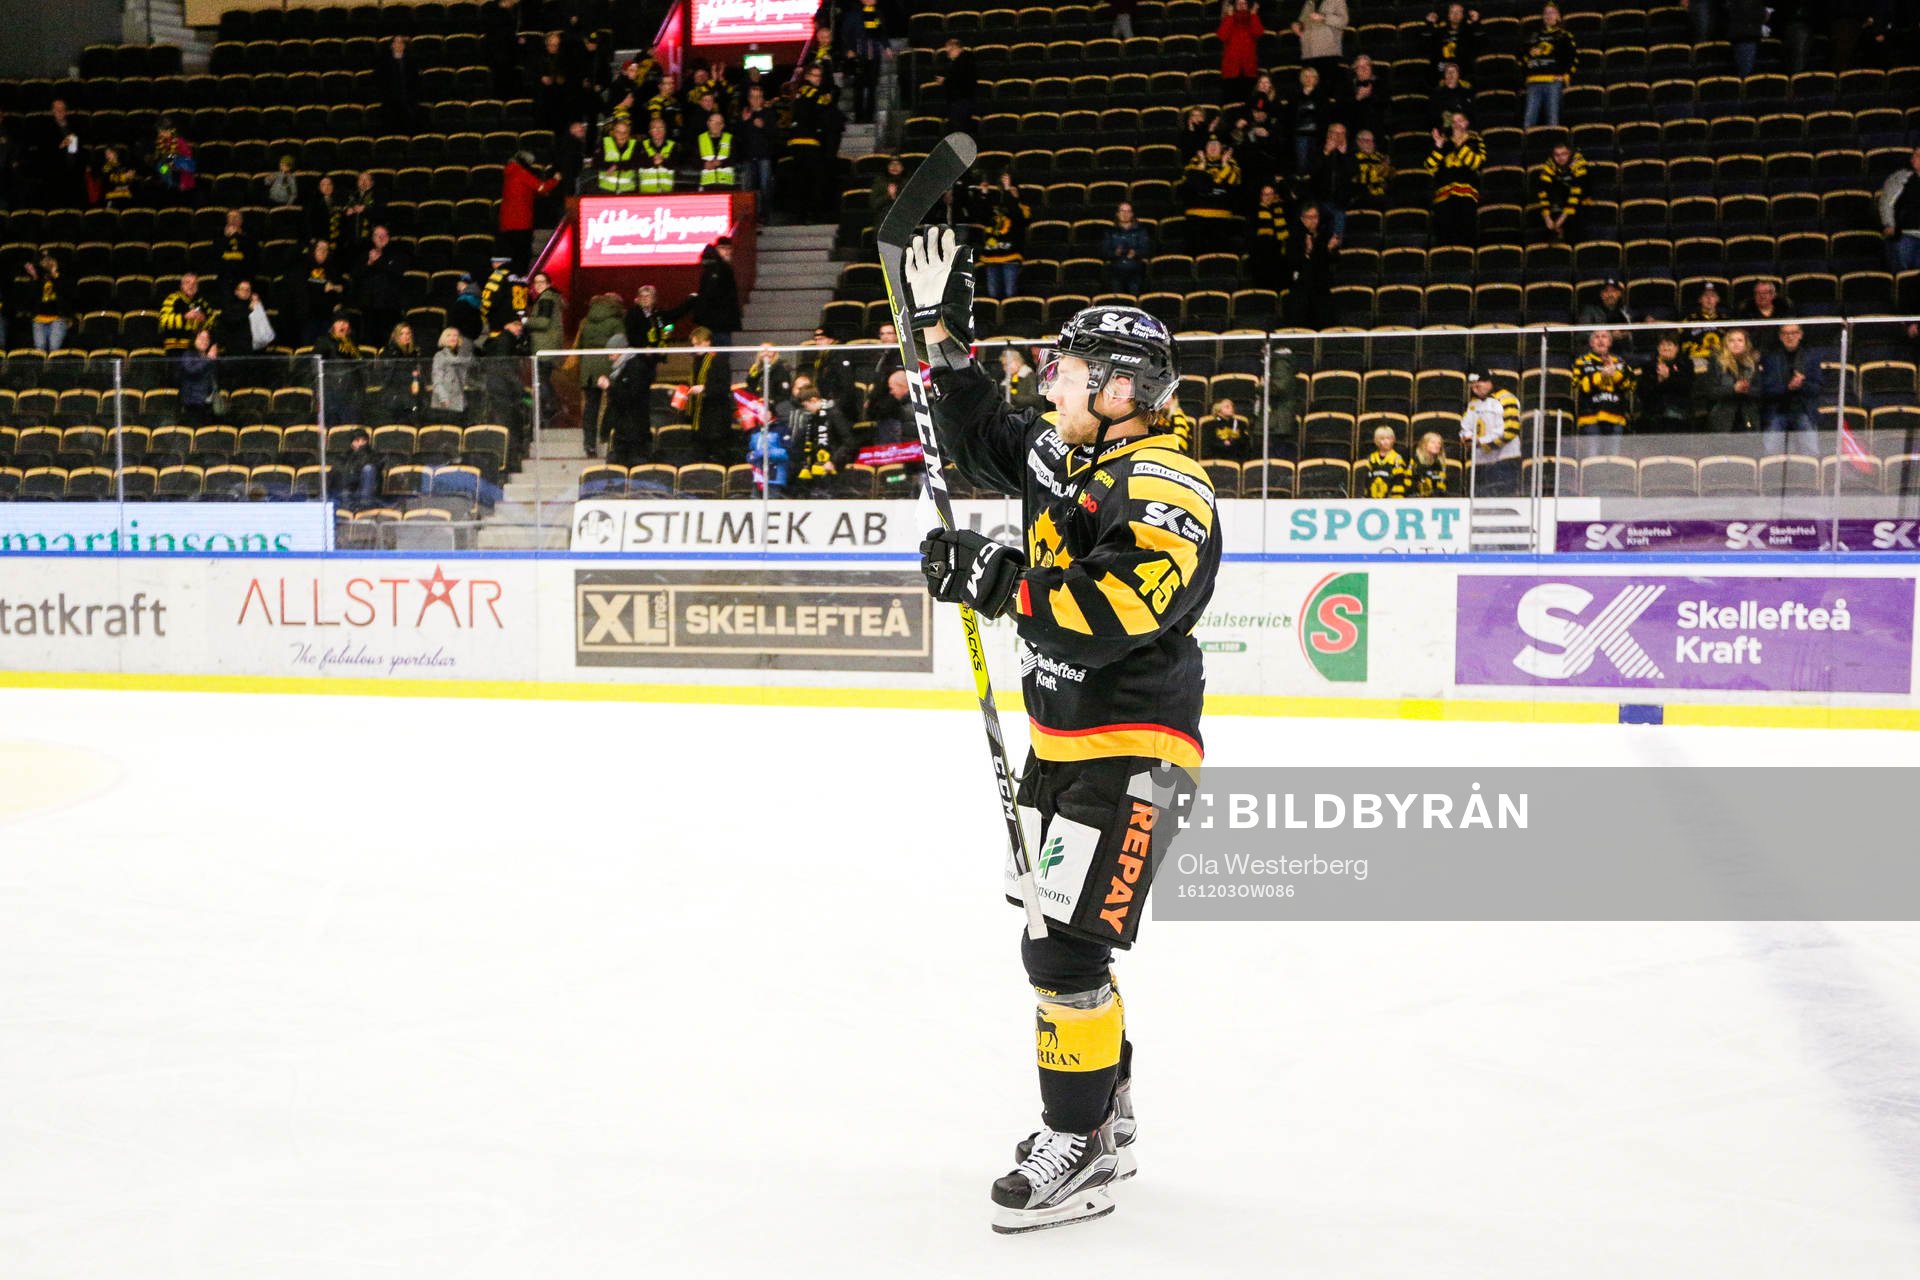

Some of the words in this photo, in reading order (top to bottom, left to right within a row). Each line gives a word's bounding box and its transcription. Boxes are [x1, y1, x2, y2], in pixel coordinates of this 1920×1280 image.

[1099, 312, 1134, 335] SK
[1110, 353, 1142, 364] CCM
[906, 370, 947, 492] CCM
[633, 511, 813, 545] STILMEK
[829, 511, 888, 546] AB
[1142, 502, 1187, 534] SK
[1290, 508, 1460, 541] SPORT
[0, 519, 292, 551] martinsons
[1585, 523, 1626, 550] SK
[1626, 537, 1650, 546] Kraft
[1725, 522, 1767, 550] SK
[1769, 536, 1792, 545] Kraft
[1872, 521, 1916, 549] SK
[237, 564, 504, 628] ALLSTAR
[1133, 558, 1181, 615] 45
[0, 593, 167, 637] tatkraft
[584, 593, 667, 643] XL
[686, 599, 912, 638] SKELLEFTEÅ
[1676, 598, 1851, 631] Skellefteå
[962, 612, 982, 671] TACKS
[1513, 583, 1666, 680] SK
[290, 642, 317, 666] The
[318, 641, 383, 671] fabulous
[388, 643, 456, 675] sportsbar
[1675, 635, 1762, 664] Kraft
[1036, 670, 1058, 692] Kraft
[993, 753, 1017, 822] CCM
[1099, 802, 1160, 935] REPAY
[1035, 986, 1057, 997] CCM
